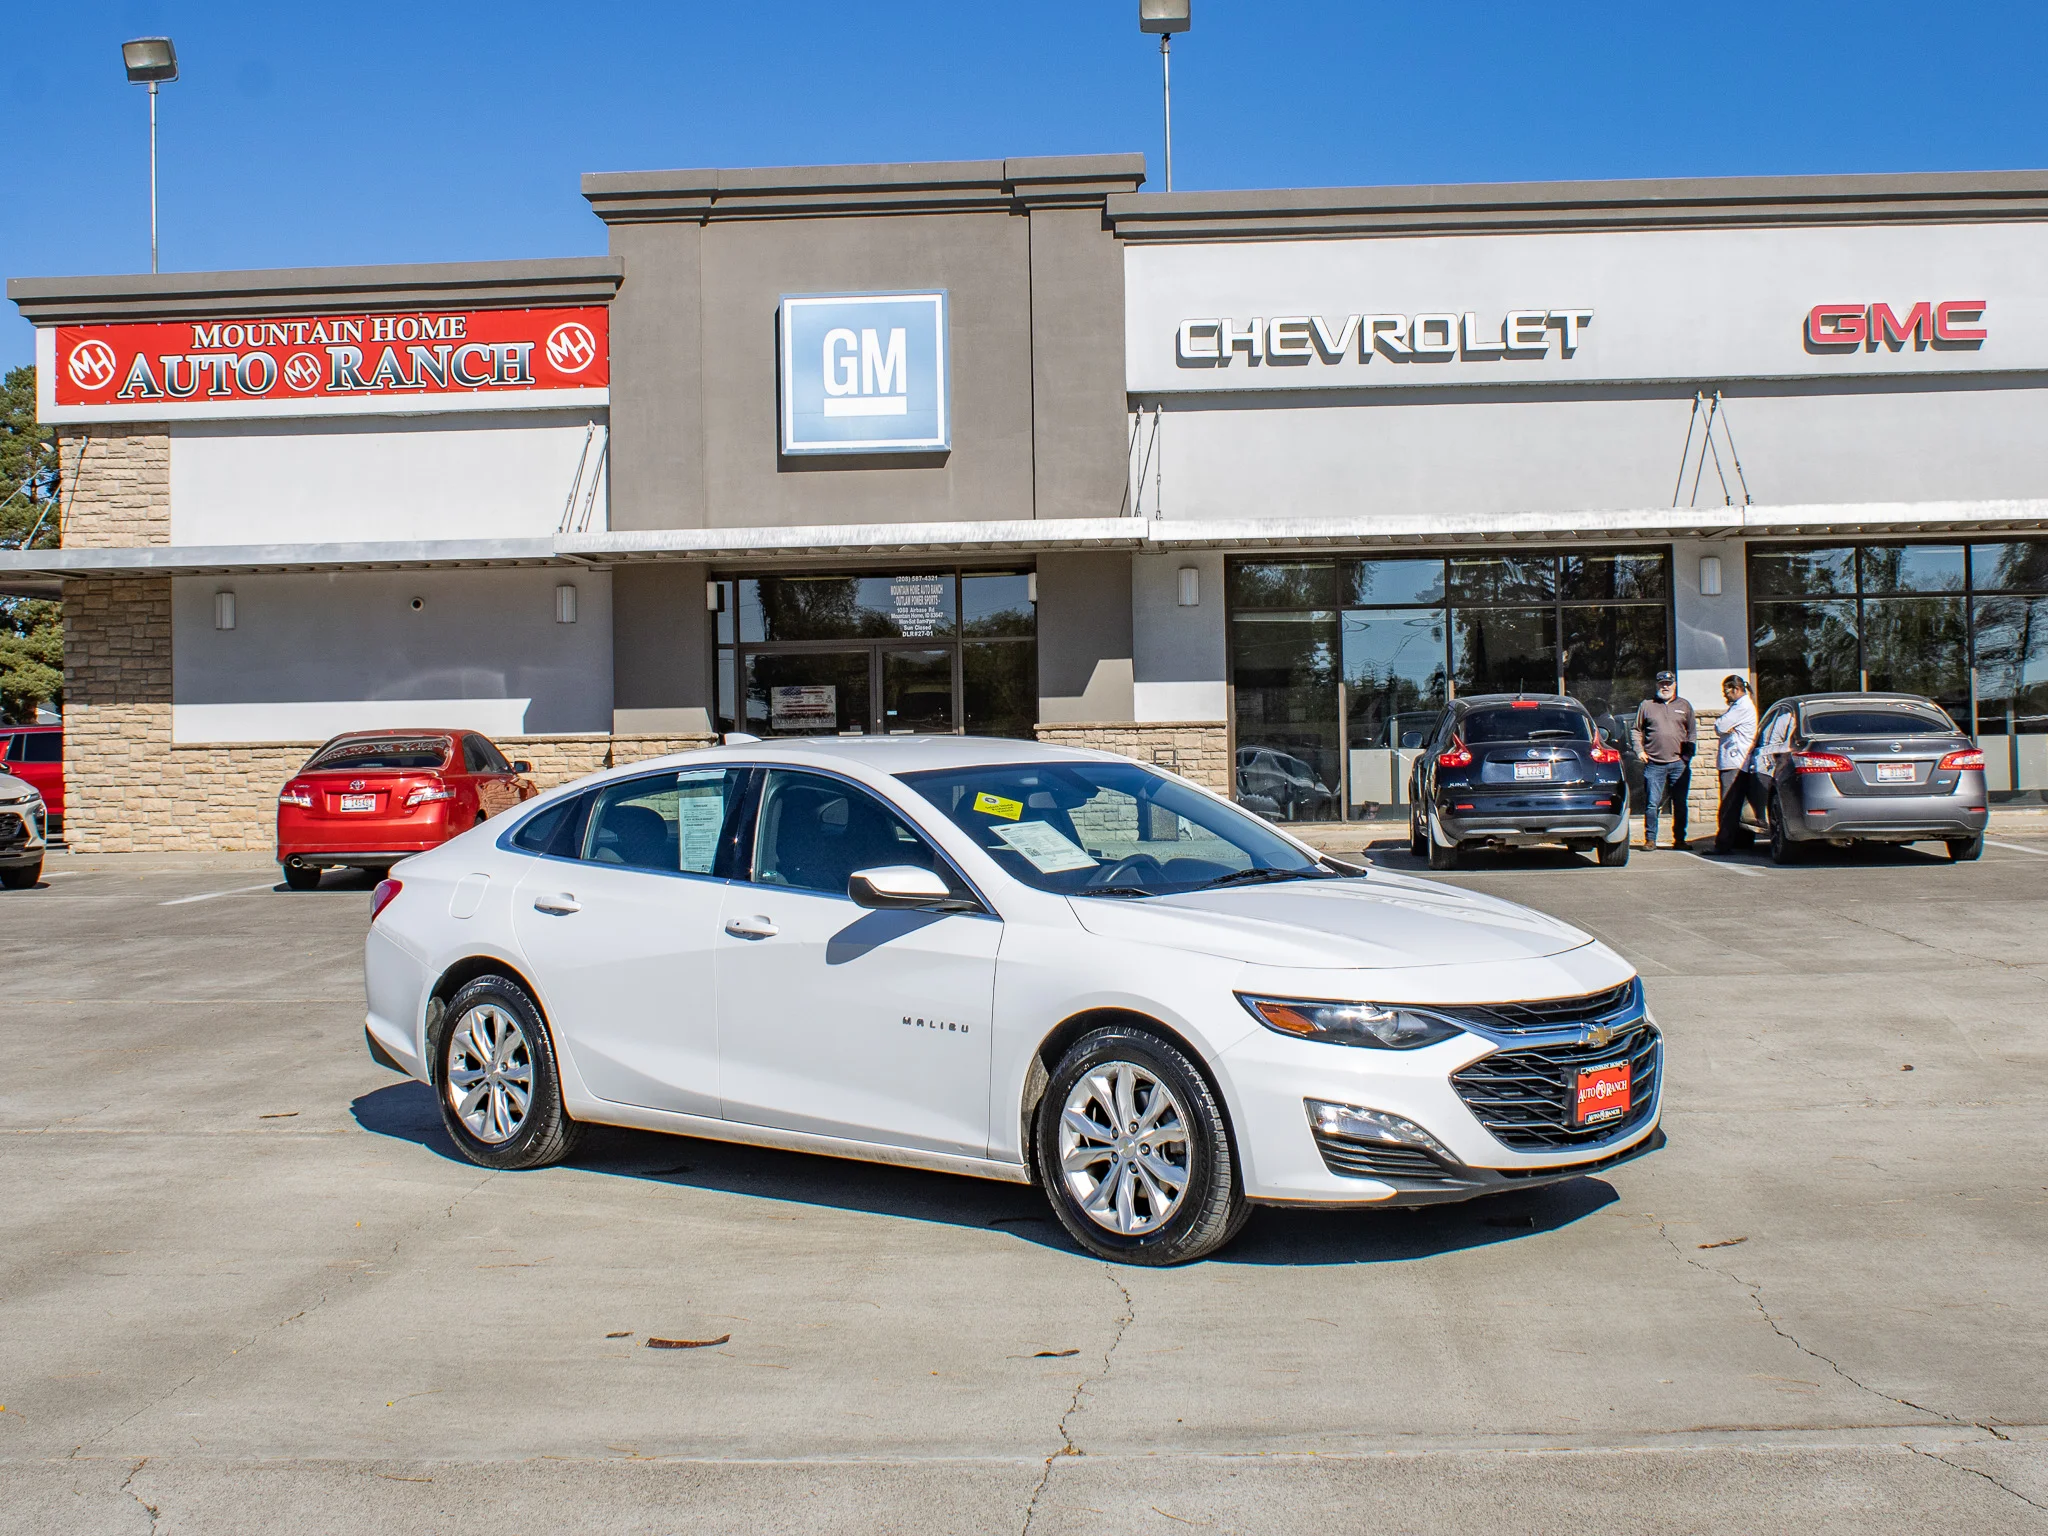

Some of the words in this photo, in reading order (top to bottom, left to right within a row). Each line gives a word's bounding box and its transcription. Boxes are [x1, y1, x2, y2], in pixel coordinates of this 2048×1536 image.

[191, 319, 365, 349] MOUNTAIN
[371, 316, 467, 342] HOME
[1179, 308, 1595, 358] CHEVROLET
[1808, 300, 1988, 345] GMC
[117, 351, 279, 400] AUTO
[325, 341, 536, 391] RANCH
[823, 328, 907, 396] GM
[891, 585, 909, 595] MOUNTAIN
[902, 1016, 968, 1033] MALIBU
[1578, 1087, 1596, 1103] AUTO
[1606, 1080, 1628, 1097] RANCH
